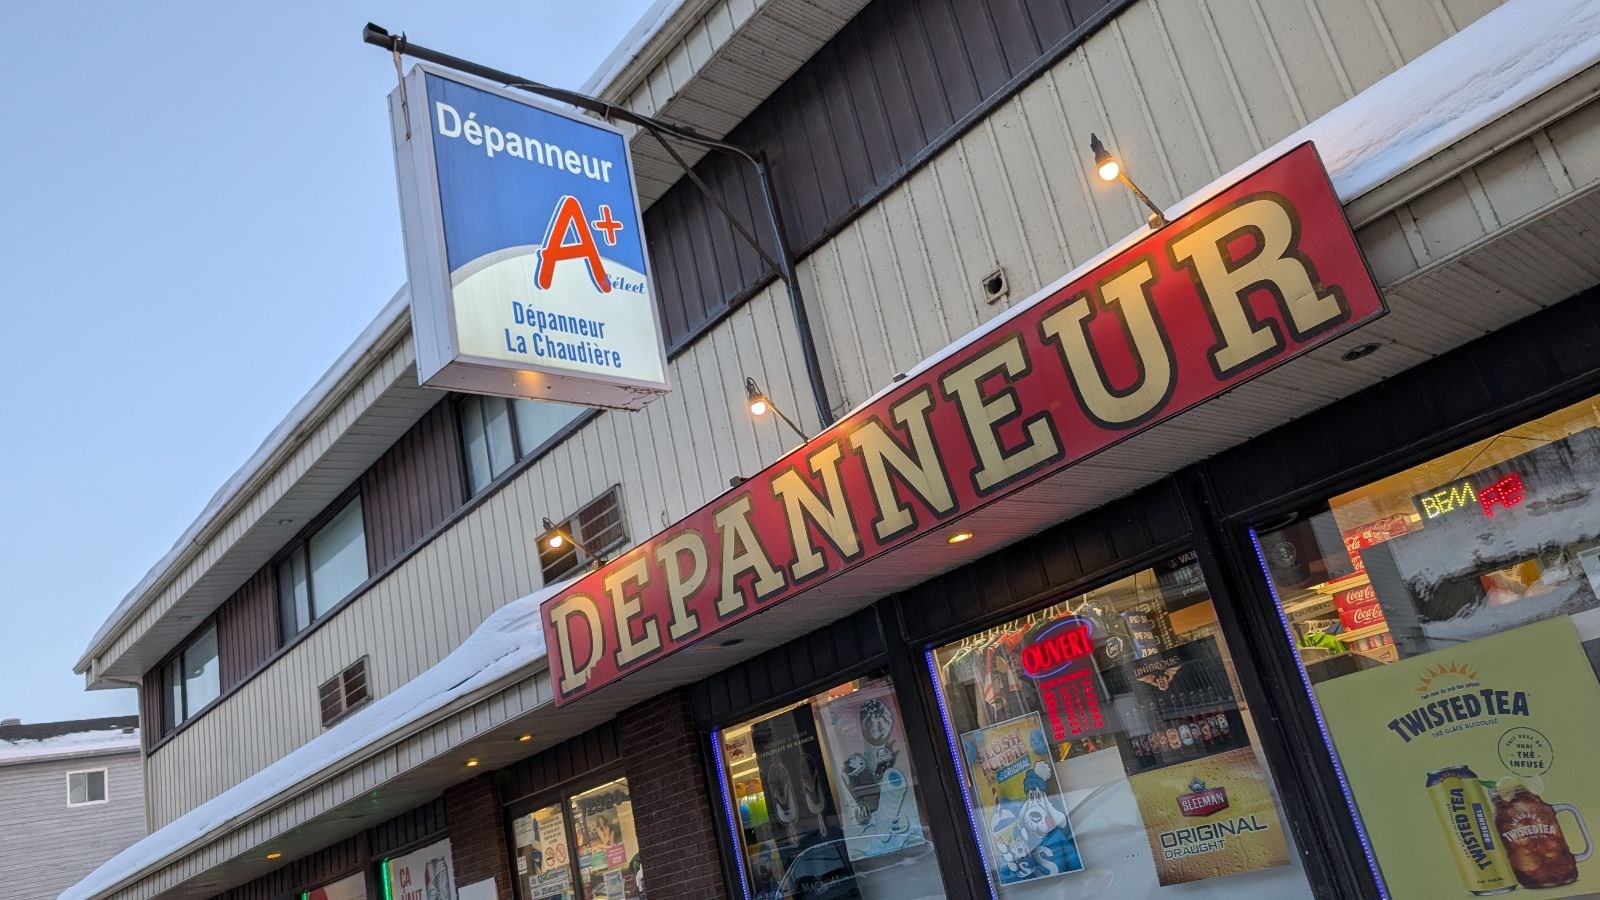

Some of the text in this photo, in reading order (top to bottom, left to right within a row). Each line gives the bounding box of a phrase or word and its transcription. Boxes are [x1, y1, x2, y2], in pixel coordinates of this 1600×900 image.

[436, 101, 613, 183] Dépanneur
[512, 300, 605, 340] Dépanneur
[504, 328, 622, 369] La Chaudière
[550, 193, 1347, 696] DEPANNEUR
[1022, 625, 1091, 675] OUVERT
[1387, 689, 1529, 744] TWISTED TEA
[1181, 793, 1225, 812] SLEEMAN
[1160, 815, 1268, 848] ORIGINAL
[1164, 840, 1226, 859] DRAUGHT
